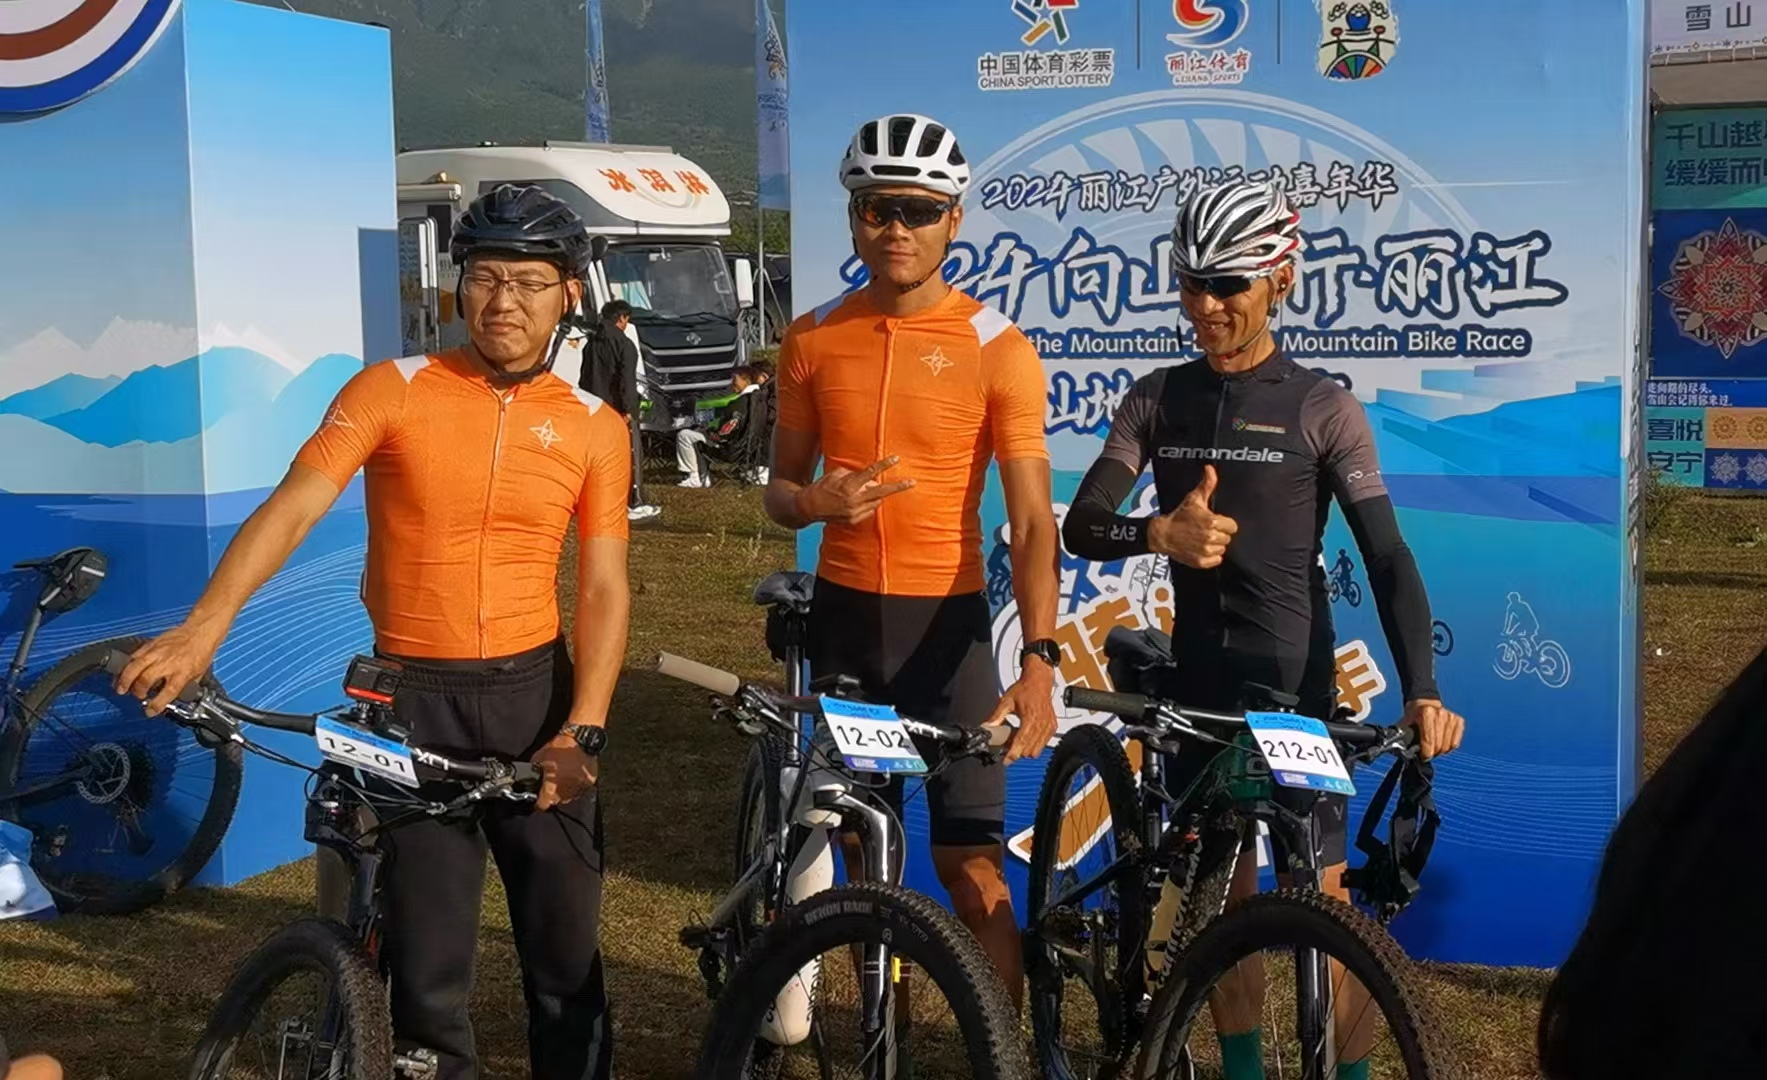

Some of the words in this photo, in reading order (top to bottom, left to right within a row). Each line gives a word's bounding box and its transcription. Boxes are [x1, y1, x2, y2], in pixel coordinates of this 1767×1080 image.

[1685, 2, 1751, 31] 雪山
[979, 50, 1113, 76] 中国体育彩票
[1167, 51, 1249, 71] 丽江体育
[980, 77, 1015, 88] CHINA
[1017, 76, 1054, 87] SPORT
[1058, 73, 1112, 85] LOTTERY
[1665, 119, 1767, 150] 千山越
[1664, 156, 1767, 187] 缓缓而
[1281, 331, 1398, 351] Mountain
[1407, 330, 1457, 351] Bike
[1465, 330, 1526, 351] Race
[1647, 418, 1703, 441] 喜悦
[1157, 445, 1285, 464] cannondale
[836, 725, 910, 749] 12-02
[324, 737, 406, 773] 12-01
[1262, 740, 1339, 767] 212-01
